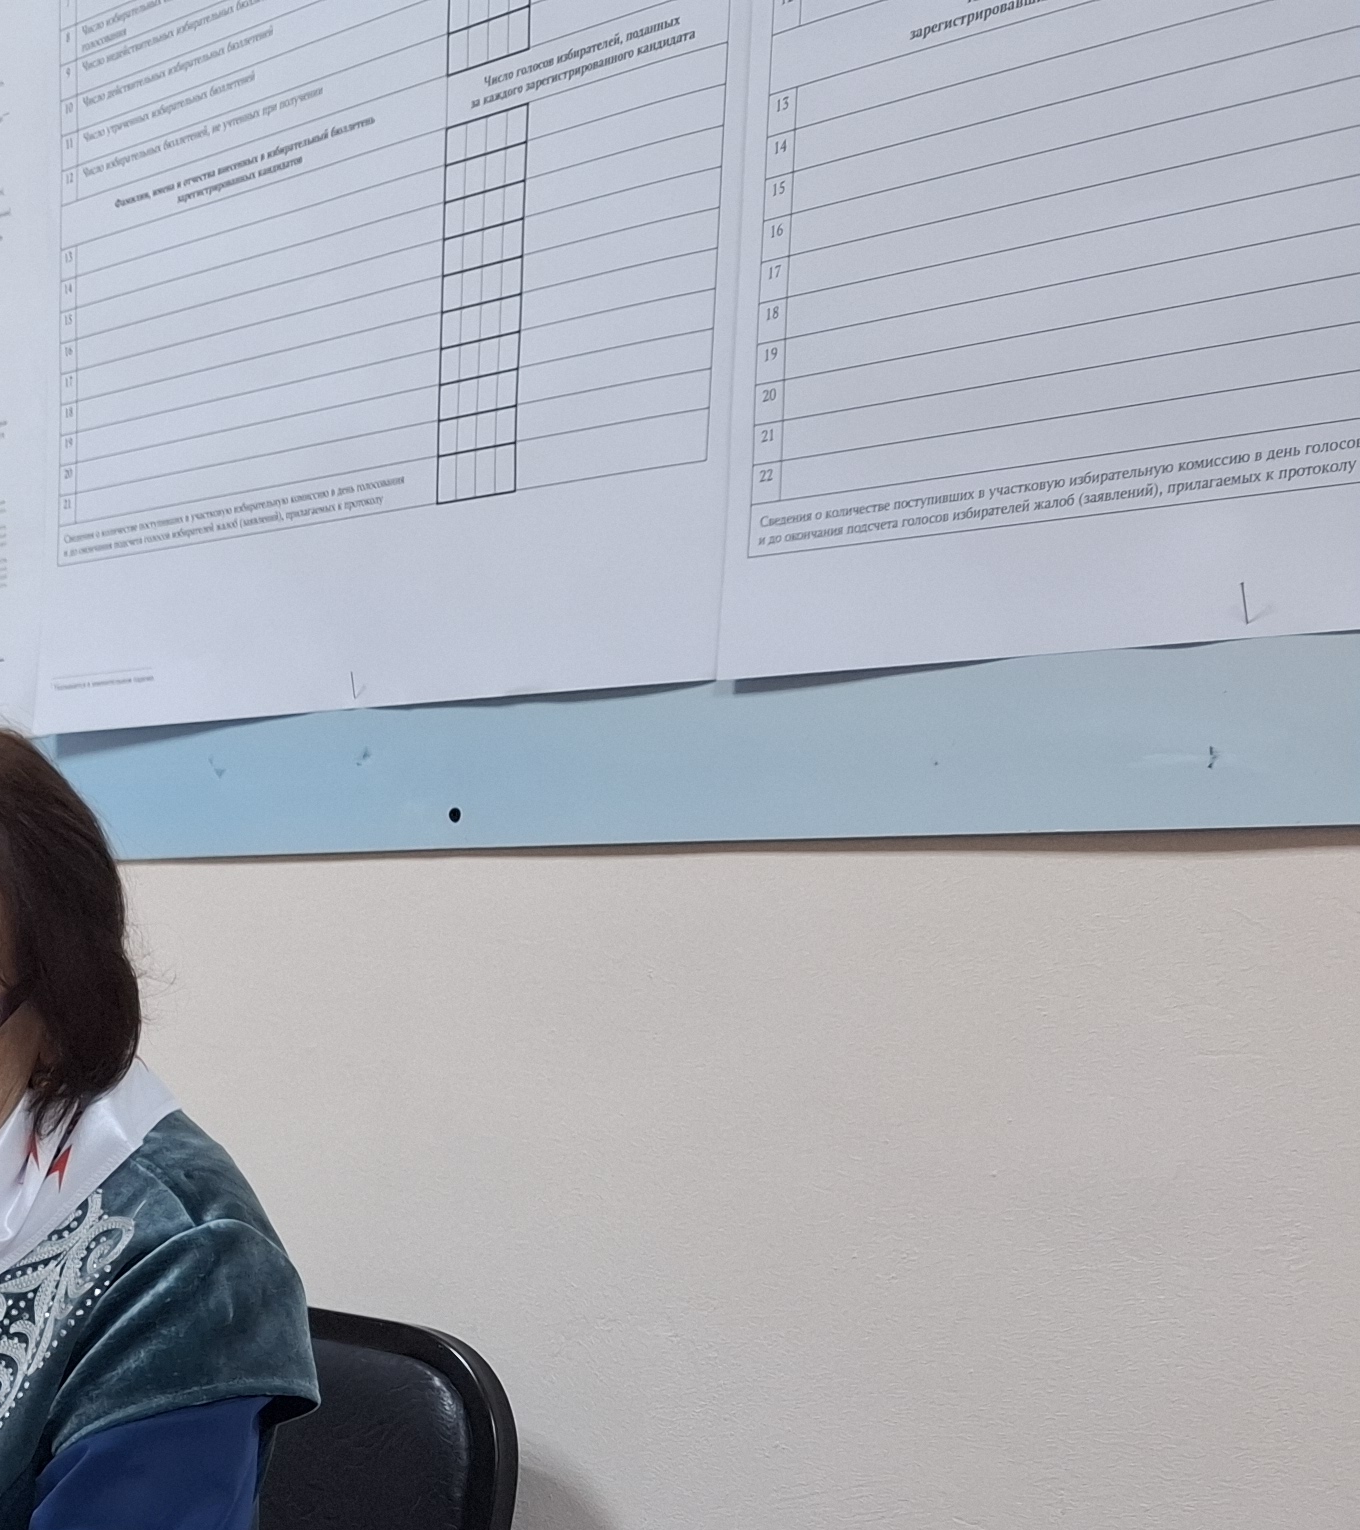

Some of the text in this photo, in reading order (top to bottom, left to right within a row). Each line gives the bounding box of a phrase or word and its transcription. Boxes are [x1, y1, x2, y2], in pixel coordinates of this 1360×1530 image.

[484, 16, 680, 87] Число голосов избирателей, поданных
[470, 30, 695, 109] за каждого зарегистрированного кандидата
[64, 101, 73, 115] 10
[776, 95, 789, 112] 13
[65, 137, 73, 149] 11
[774, 139, 786, 155] 14
[65, 172, 73, 184] 12
[772, 180, 786, 196] 15
[771, 223, 783, 238] 16
[64, 251, 72, 263] 13
[768, 264, 781, 280] 17
[64, 283, 72, 294] 14
[64, 313, 72, 325] 15
[766, 305, 779, 321] 18
[64, 346, 73, 357] 16
[764, 347, 778, 362] 19
[65, 375, 73, 388] 17
[762, 388, 776, 403] 20
[65, 406, 73, 418] 18
[64, 437, 73, 449] 19
[760, 428, 773, 443] 21
[63, 467, 73, 479] 20
[759, 468, 773, 483] 22
[759, 512, 812, 527] Сведения
[814, 511, 822, 520] о
[824, 502, 890, 519] количестве
[893, 490, 974, 510] поступивших
[989, 478, 1065, 500] участковую
[1069, 463, 1173, 487] избирательную
[1177, 453, 1250, 472] комиссию
[1254, 451, 1262, 462] в
[1266, 446, 1300, 462] день
[63, 498, 71, 509] 21
[767, 534, 782, 546] до
[846, 519, 898, 534] подсчета
[901, 512, 949, 528] голосов
[952, 499, 1030, 521] избирателей
[1033, 493, 1075, 511] жалоб
[1078, 482, 1162, 507] (заявлений),
[1166, 472, 1261, 496] прилагаемых
[1265, 471, 1274, 482] к
[1278, 460, 1352, 481] протоколу
